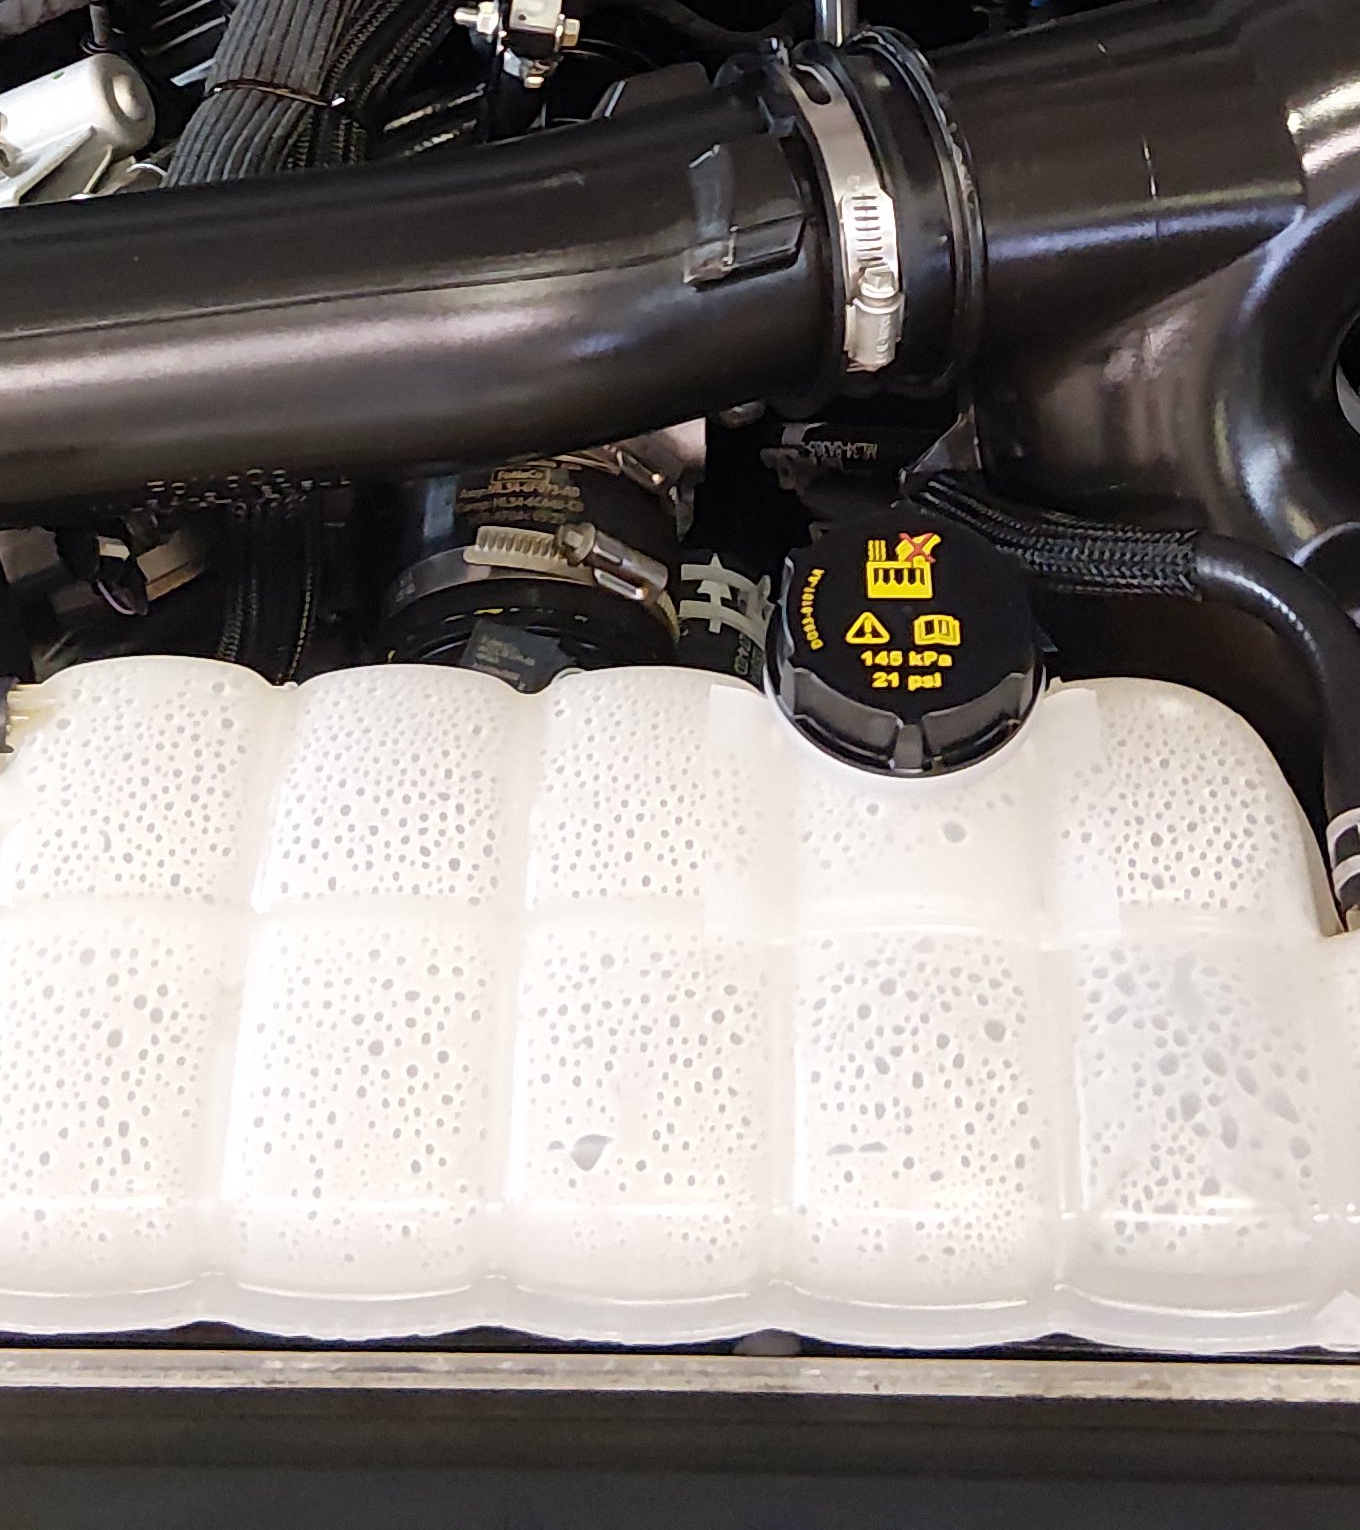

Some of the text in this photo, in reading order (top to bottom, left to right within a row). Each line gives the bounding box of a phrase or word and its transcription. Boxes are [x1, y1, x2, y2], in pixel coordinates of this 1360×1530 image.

[861, 650, 954, 667] 145 kPa
[872, 672, 943, 692] 21 psi
